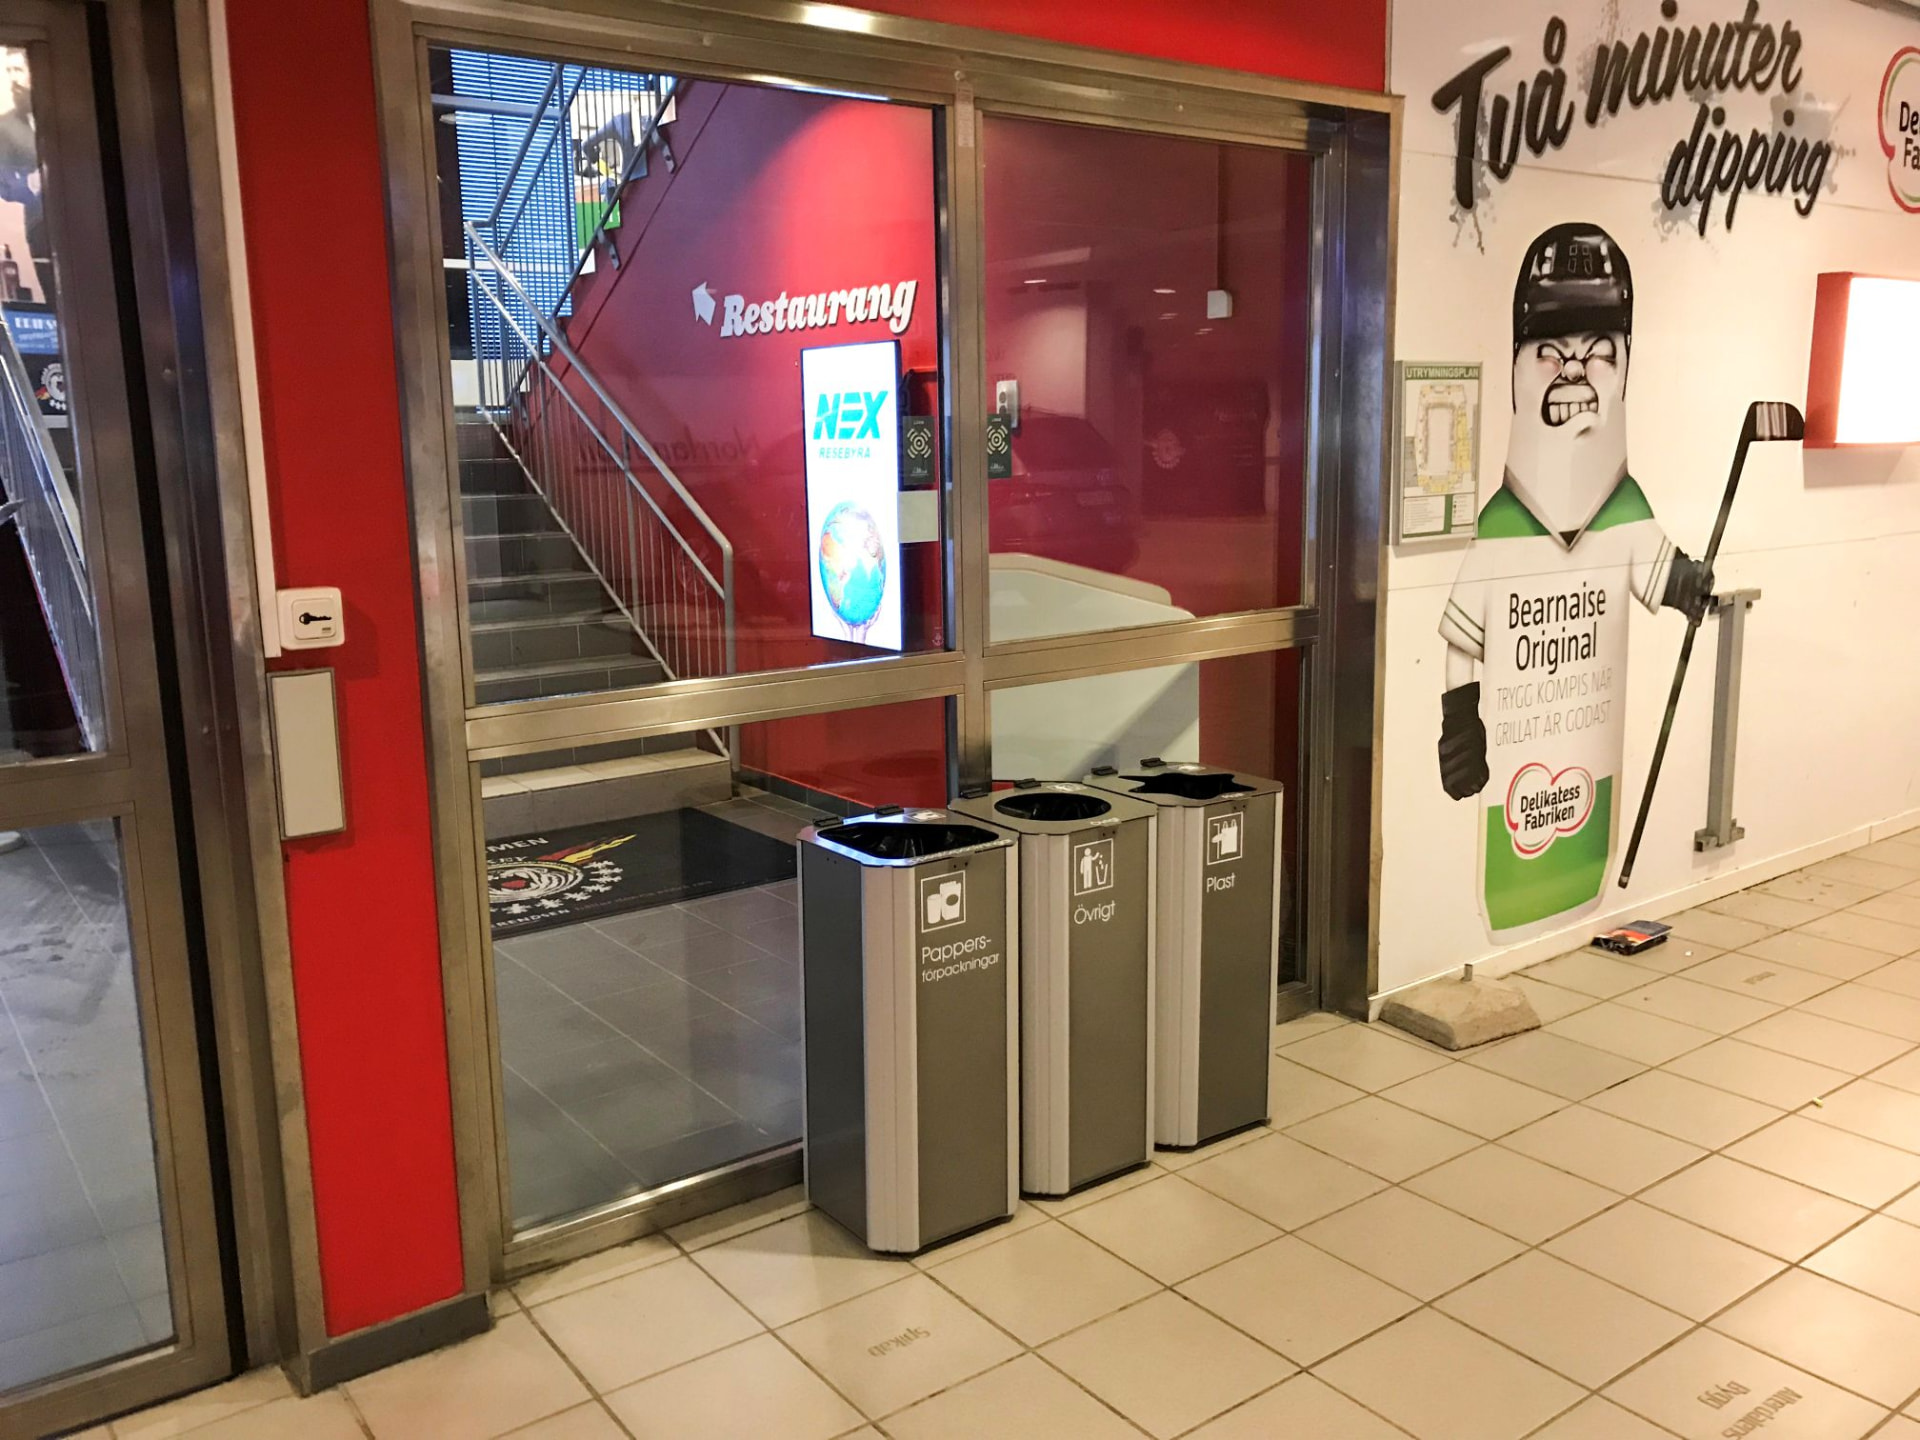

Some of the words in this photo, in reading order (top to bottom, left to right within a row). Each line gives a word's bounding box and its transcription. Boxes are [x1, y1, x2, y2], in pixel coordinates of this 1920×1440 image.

[1432, 15, 1575, 210] Två
[1585, 0, 1803, 128] minuter
[1662, 102, 1831, 237] dipping
[720, 280, 918, 338] Restaurang
[1405, 366, 1479, 379] UTRYMNINGSPLAN
[813, 390, 889, 440] NEX
[1509, 581, 1607, 630] Bearnaise
[1516, 621, 1597, 675] Original
[1496, 683, 1533, 712] TRYGG
[1537, 672, 1588, 705] KOMPIS
[1495, 716, 1541, 747] GRILLAT
[1543, 710, 1562, 738] ÄR
[1565, 700, 1612, 733] GODAST
[1520, 785, 1581, 814] Delikatess
[1524, 805, 1575, 832] Fabriken
[485, 837, 549, 853] MEN
[1206, 872, 1236, 893] Plast
[1073, 900, 1116, 925] Övrigt
[922, 935, 992, 965] Pappers-
[922, 953, 999, 983] förpackningar
[1697, 1380, 1751, 1411] Bygg
